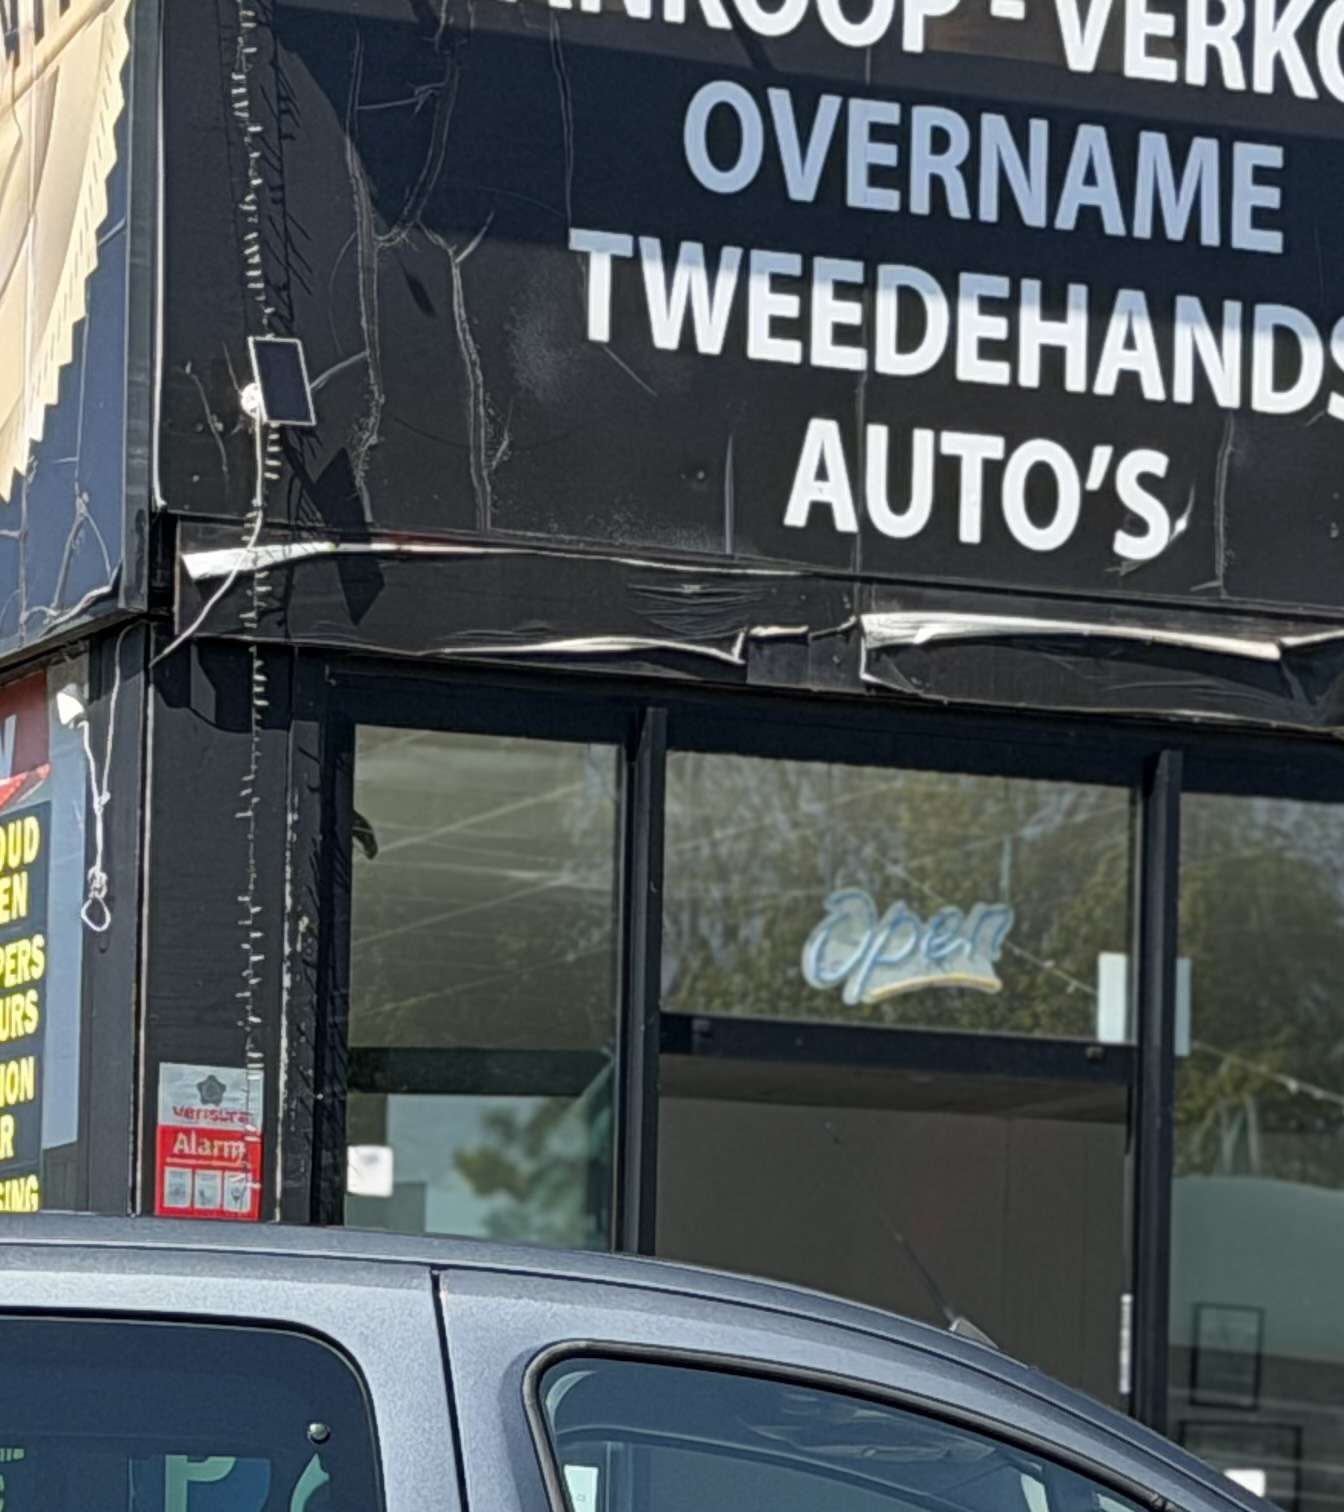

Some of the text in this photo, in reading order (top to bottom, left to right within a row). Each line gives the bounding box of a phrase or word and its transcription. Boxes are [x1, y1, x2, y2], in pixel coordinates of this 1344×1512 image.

[683, 80, 1284, 253] OVERNAME
[783, 417, 1172, 561] AUTO'S
[802, 887, 1013, 1004] Open
[172, 1129, 248, 1160] Alarm
